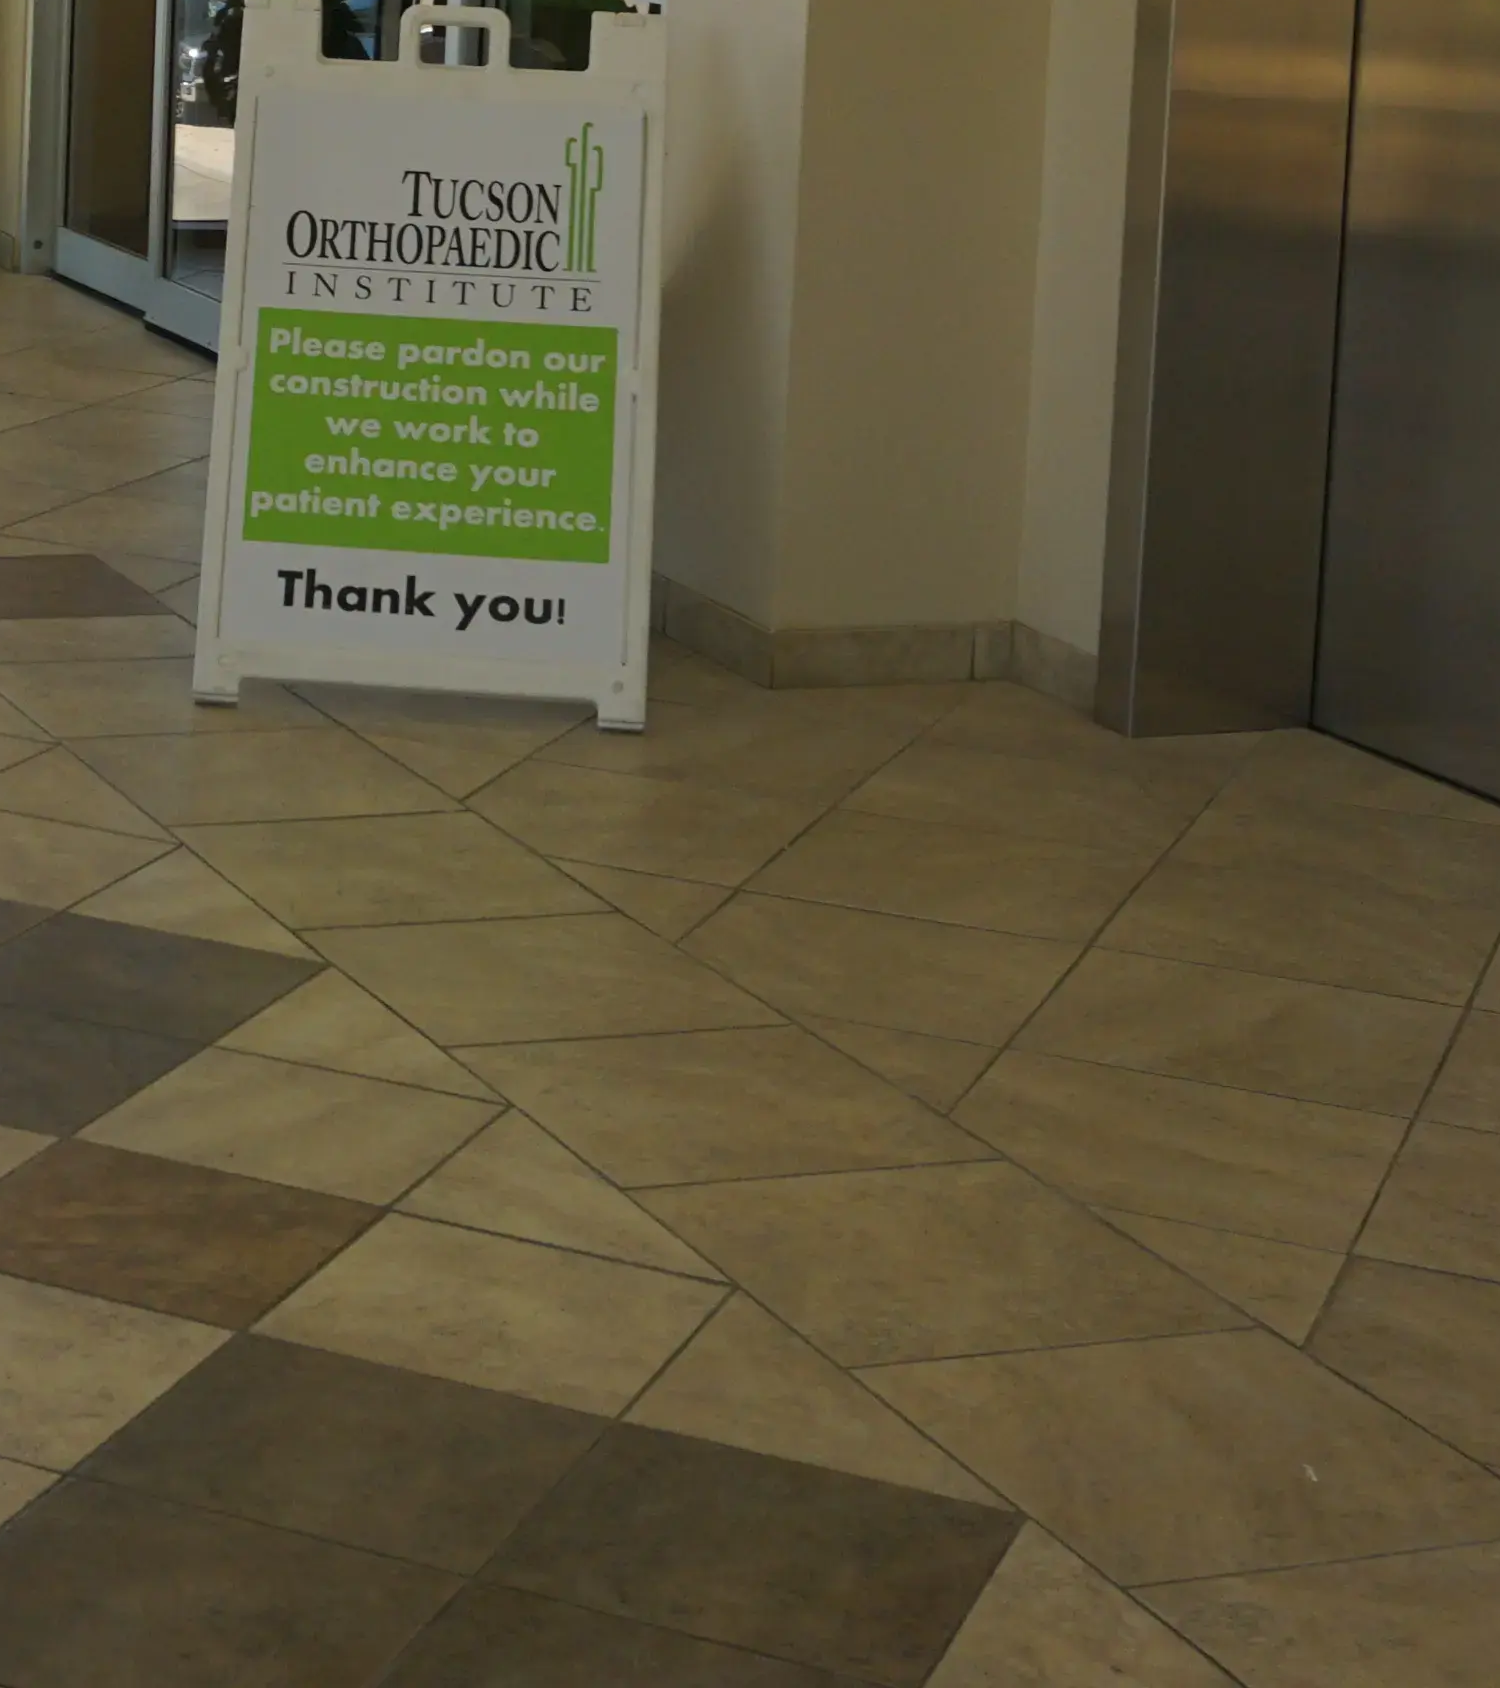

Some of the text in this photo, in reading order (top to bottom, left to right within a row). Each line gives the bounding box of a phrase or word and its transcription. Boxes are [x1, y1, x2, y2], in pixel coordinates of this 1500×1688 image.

[402, 170, 562, 225] TUCSON
[286, 210, 560, 272] ORTHOPAEDIC
[286, 270, 593, 312] INSTITUTE
[269, 327, 606, 373] Please pardon our
[269, 373, 600, 412] construction while
[325, 414, 540, 448] we work to
[304, 446, 557, 492] enhance your
[250, 485, 605, 532] patient experience.
[277, 568, 566, 631] Thank you!
